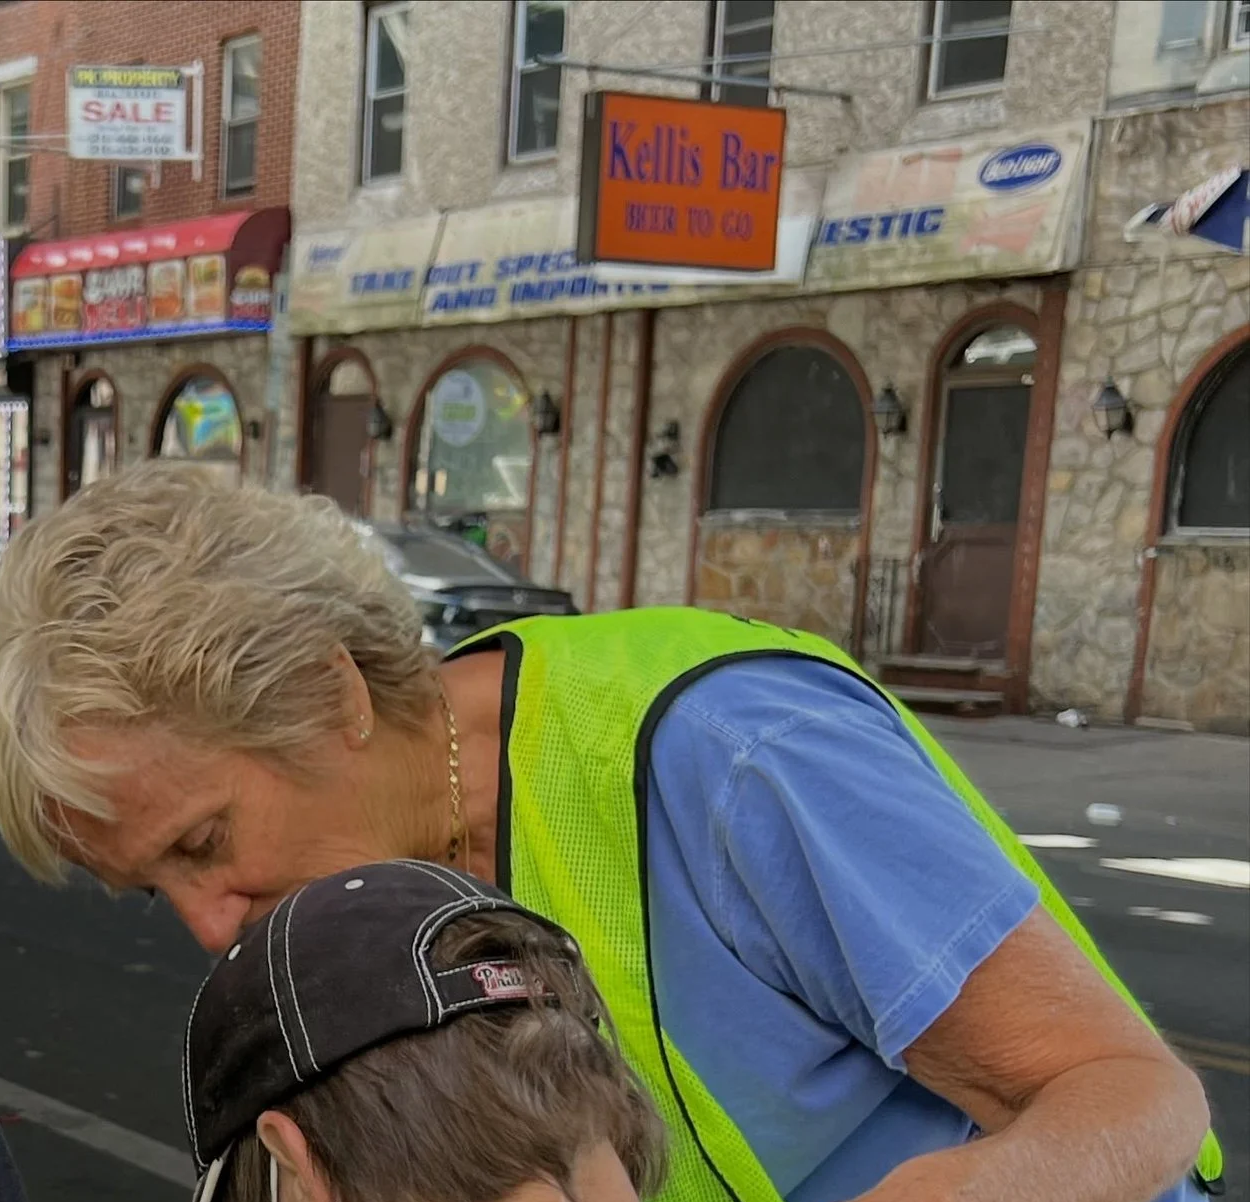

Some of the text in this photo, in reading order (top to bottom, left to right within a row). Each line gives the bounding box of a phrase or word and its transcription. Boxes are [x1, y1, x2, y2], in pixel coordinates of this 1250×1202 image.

[81, 101, 175, 124] SALE
[609, 120, 777, 193] Kellis Bar
[626, 201, 755, 242] BEER TO GO
[817, 208, 945, 245] ESTIC
[496, 249, 579, 280] SPEC
[432, 287, 497, 313] AND
[473, 965, 545, 998] Phill
